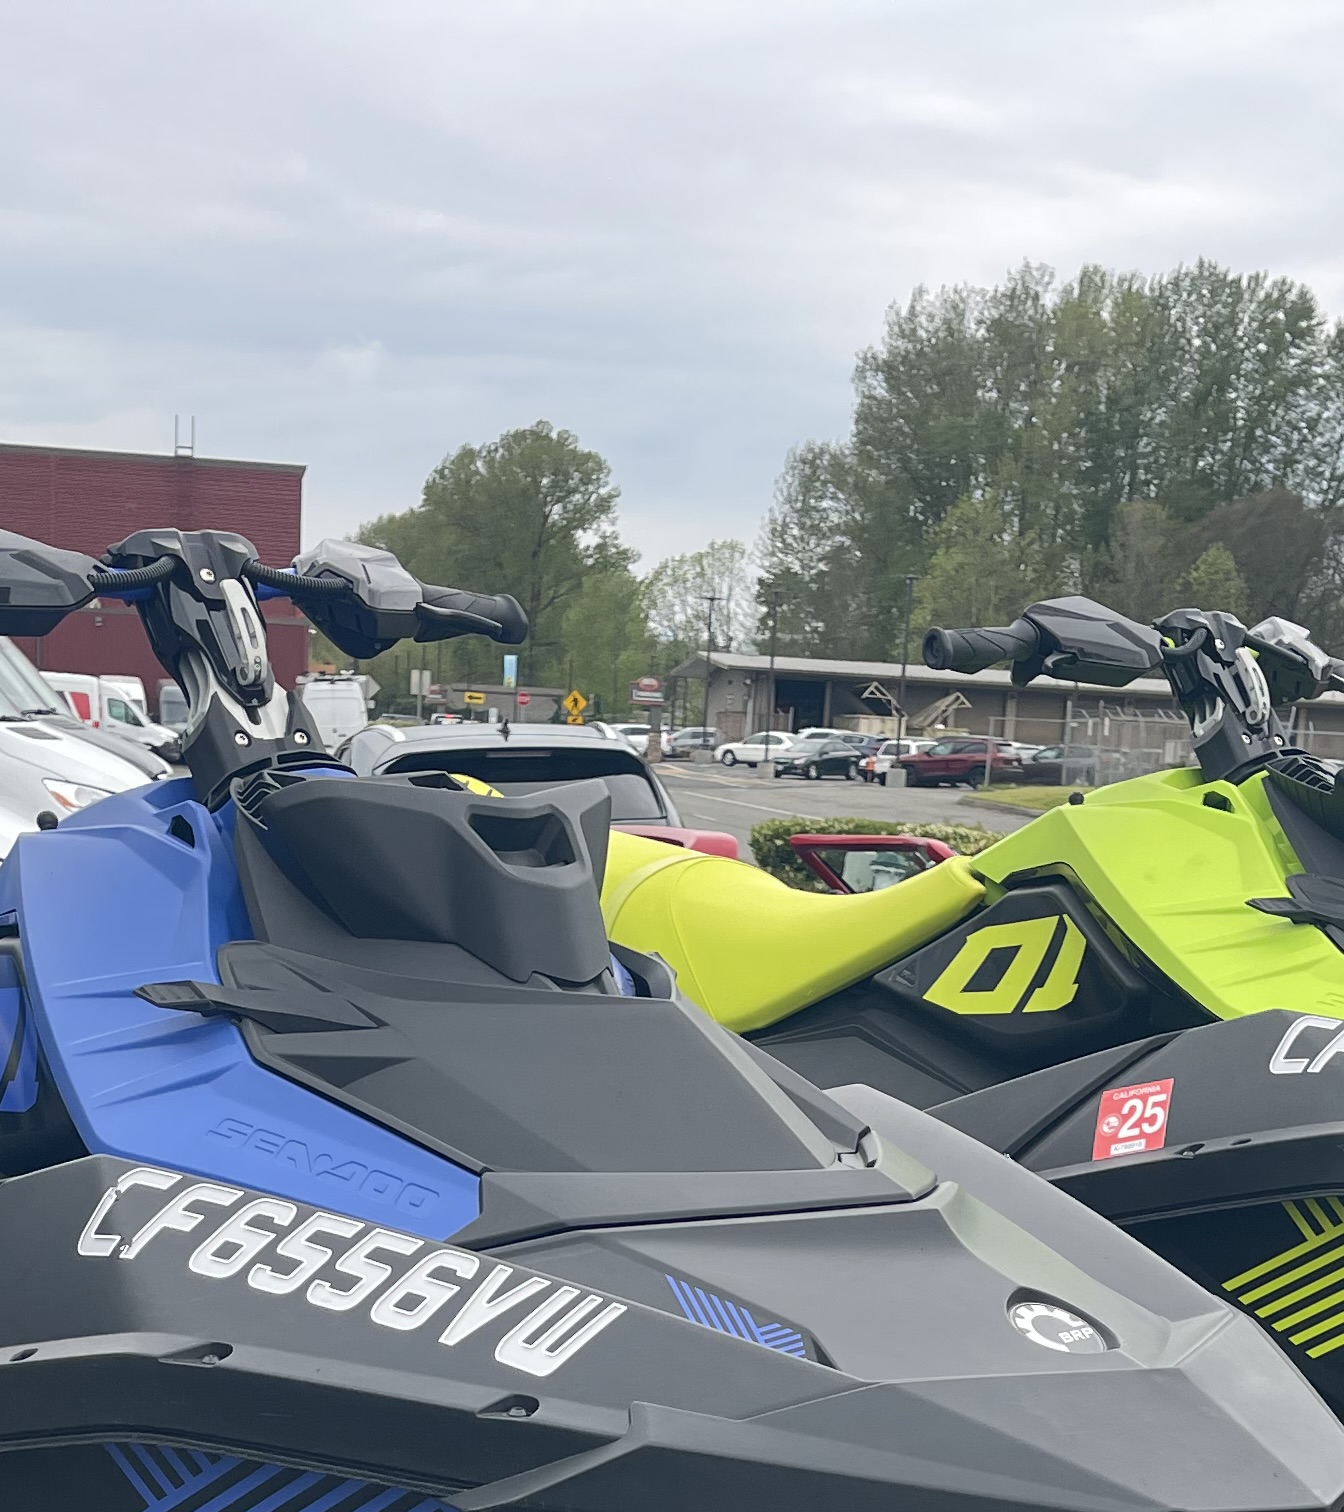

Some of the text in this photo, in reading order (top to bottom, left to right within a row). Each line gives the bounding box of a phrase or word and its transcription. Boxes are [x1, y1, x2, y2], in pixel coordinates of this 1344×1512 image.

[1112, 1084, 1161, 1101] CALIFORNIA
[1117, 1093, 1168, 1139] 25
[77, 1167, 628, 1378] CF6556VW
[1058, 1326, 1094, 1344] BRP
